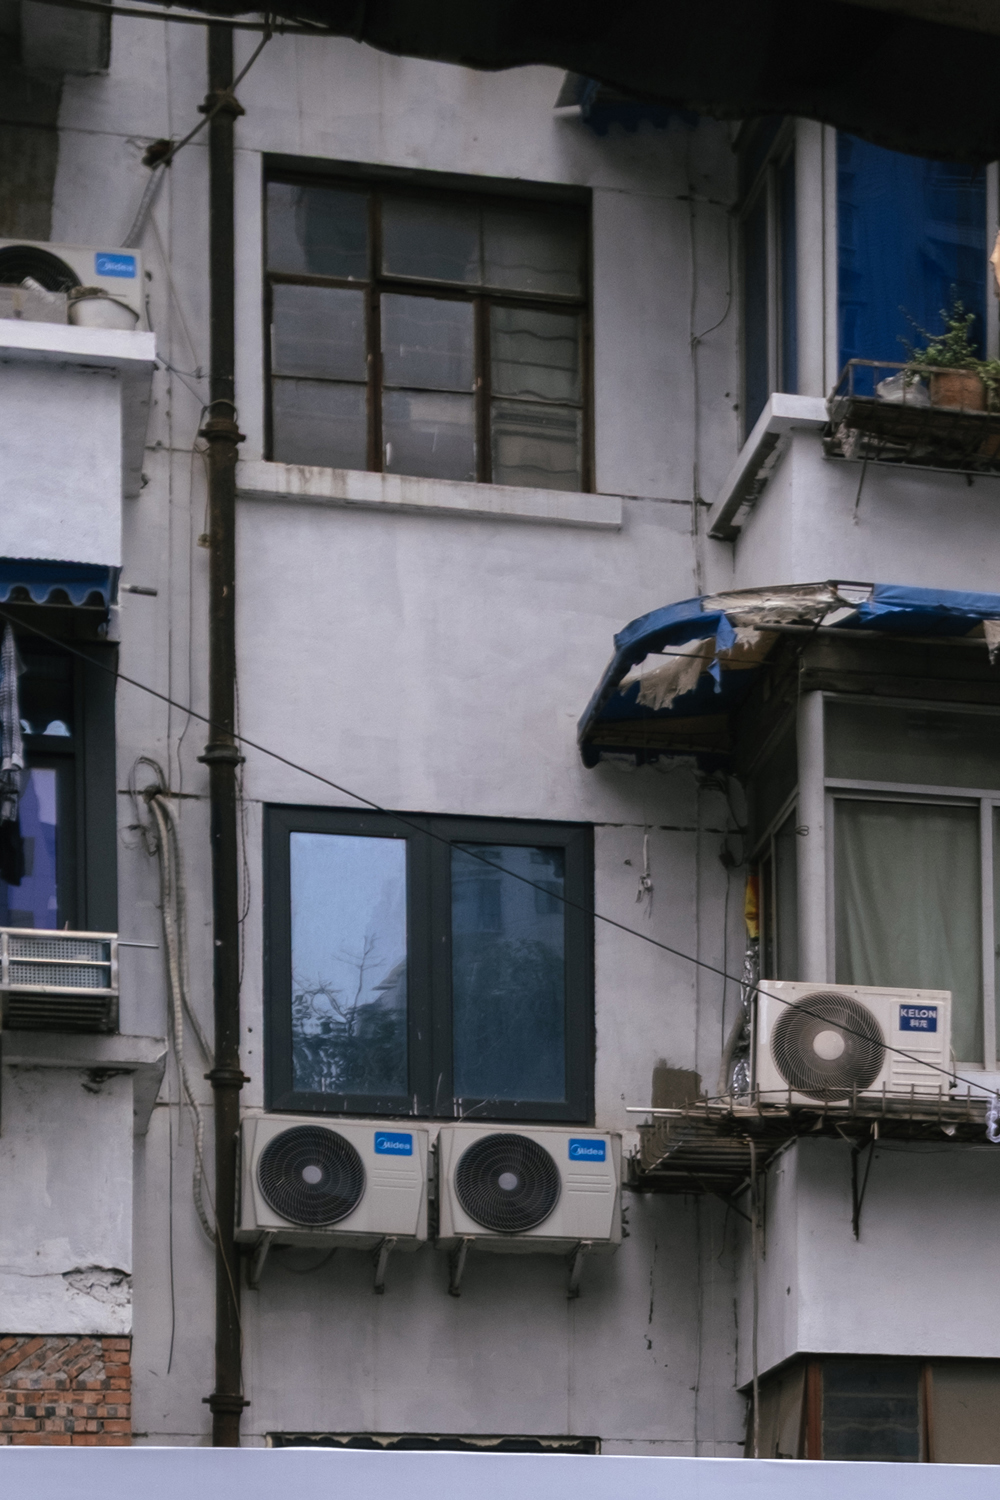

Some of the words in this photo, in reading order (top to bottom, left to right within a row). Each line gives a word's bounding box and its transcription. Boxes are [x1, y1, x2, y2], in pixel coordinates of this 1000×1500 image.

[900, 1008, 937, 1018] KELON
[382, 1141, 410, 1150] Midea
[575, 1147, 604, 1156] Midea
